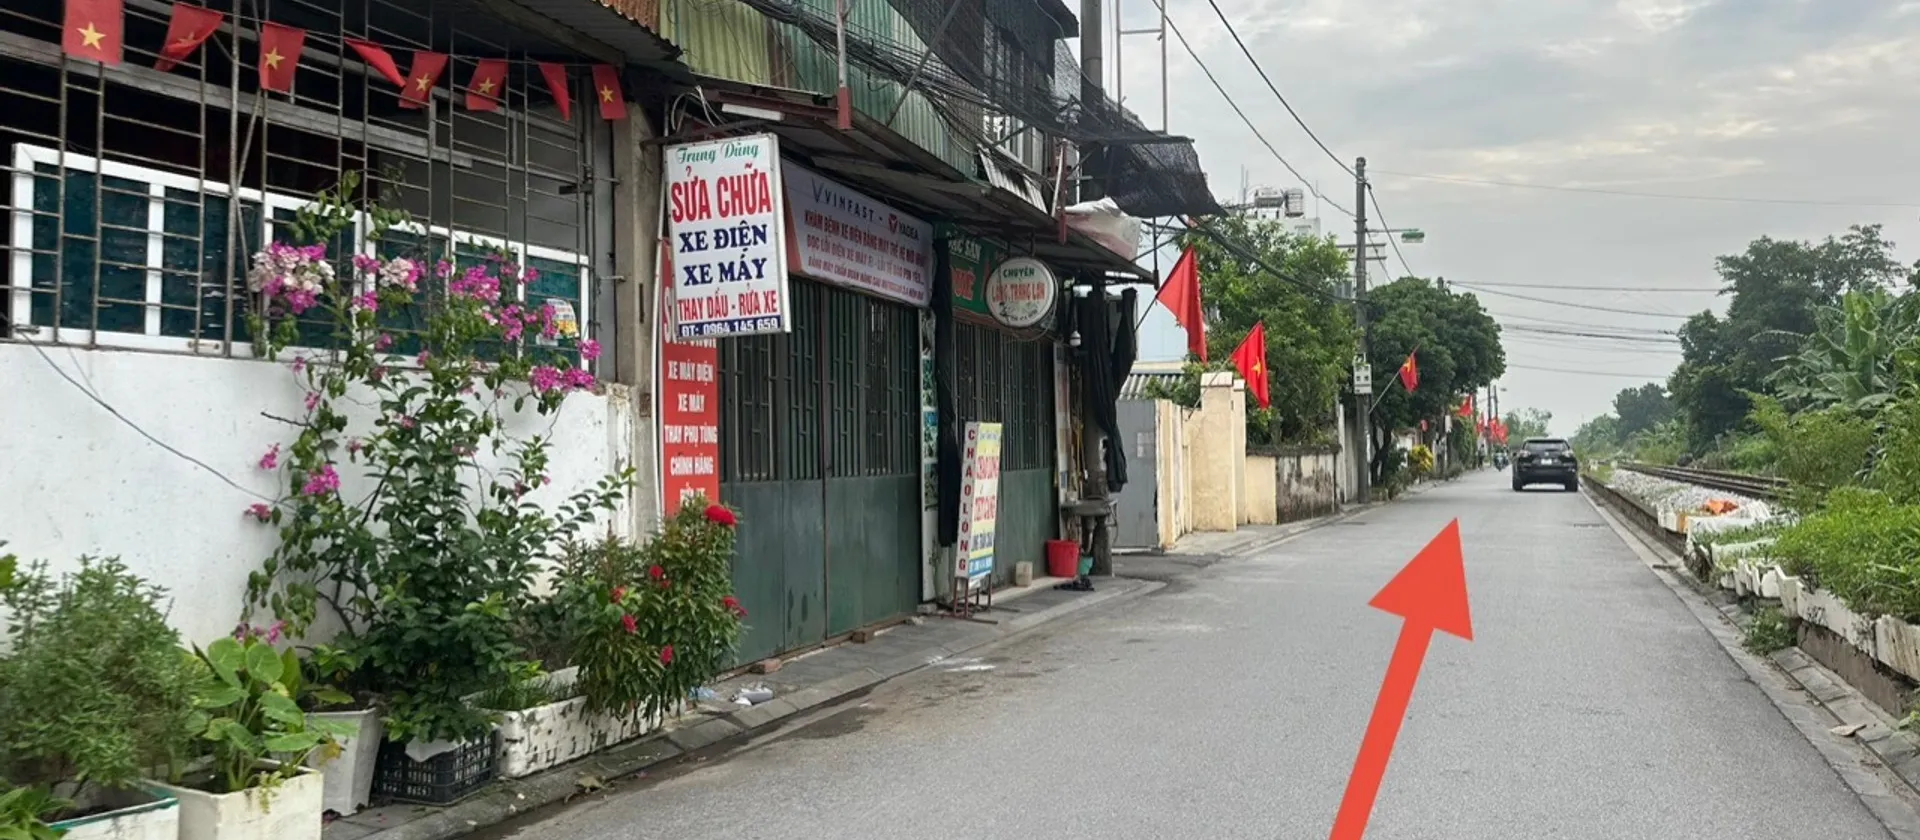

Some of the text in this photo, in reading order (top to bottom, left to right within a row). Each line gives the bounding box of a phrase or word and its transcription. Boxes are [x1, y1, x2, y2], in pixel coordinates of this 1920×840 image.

[675, 146, 717, 165] Trung
[671, 162, 772, 224] SỬA CHỮA
[825, 189, 875, 222] VINFAST
[679, 219, 768, 254] XE ĐIỆN
[683, 253, 768, 287] XE MÁY
[677, 298, 705, 322] THAY
[706, 287, 729, 319] DẤU
[738, 283, 760, 316] RỬA
[763, 290, 777, 314] XE
[702, 320, 730, 335] 0964
[734, 318, 755, 332] 145
[756, 317, 780, 331] 659
[667, 360, 678, 380] XE
[677, 392, 688, 412] XE
